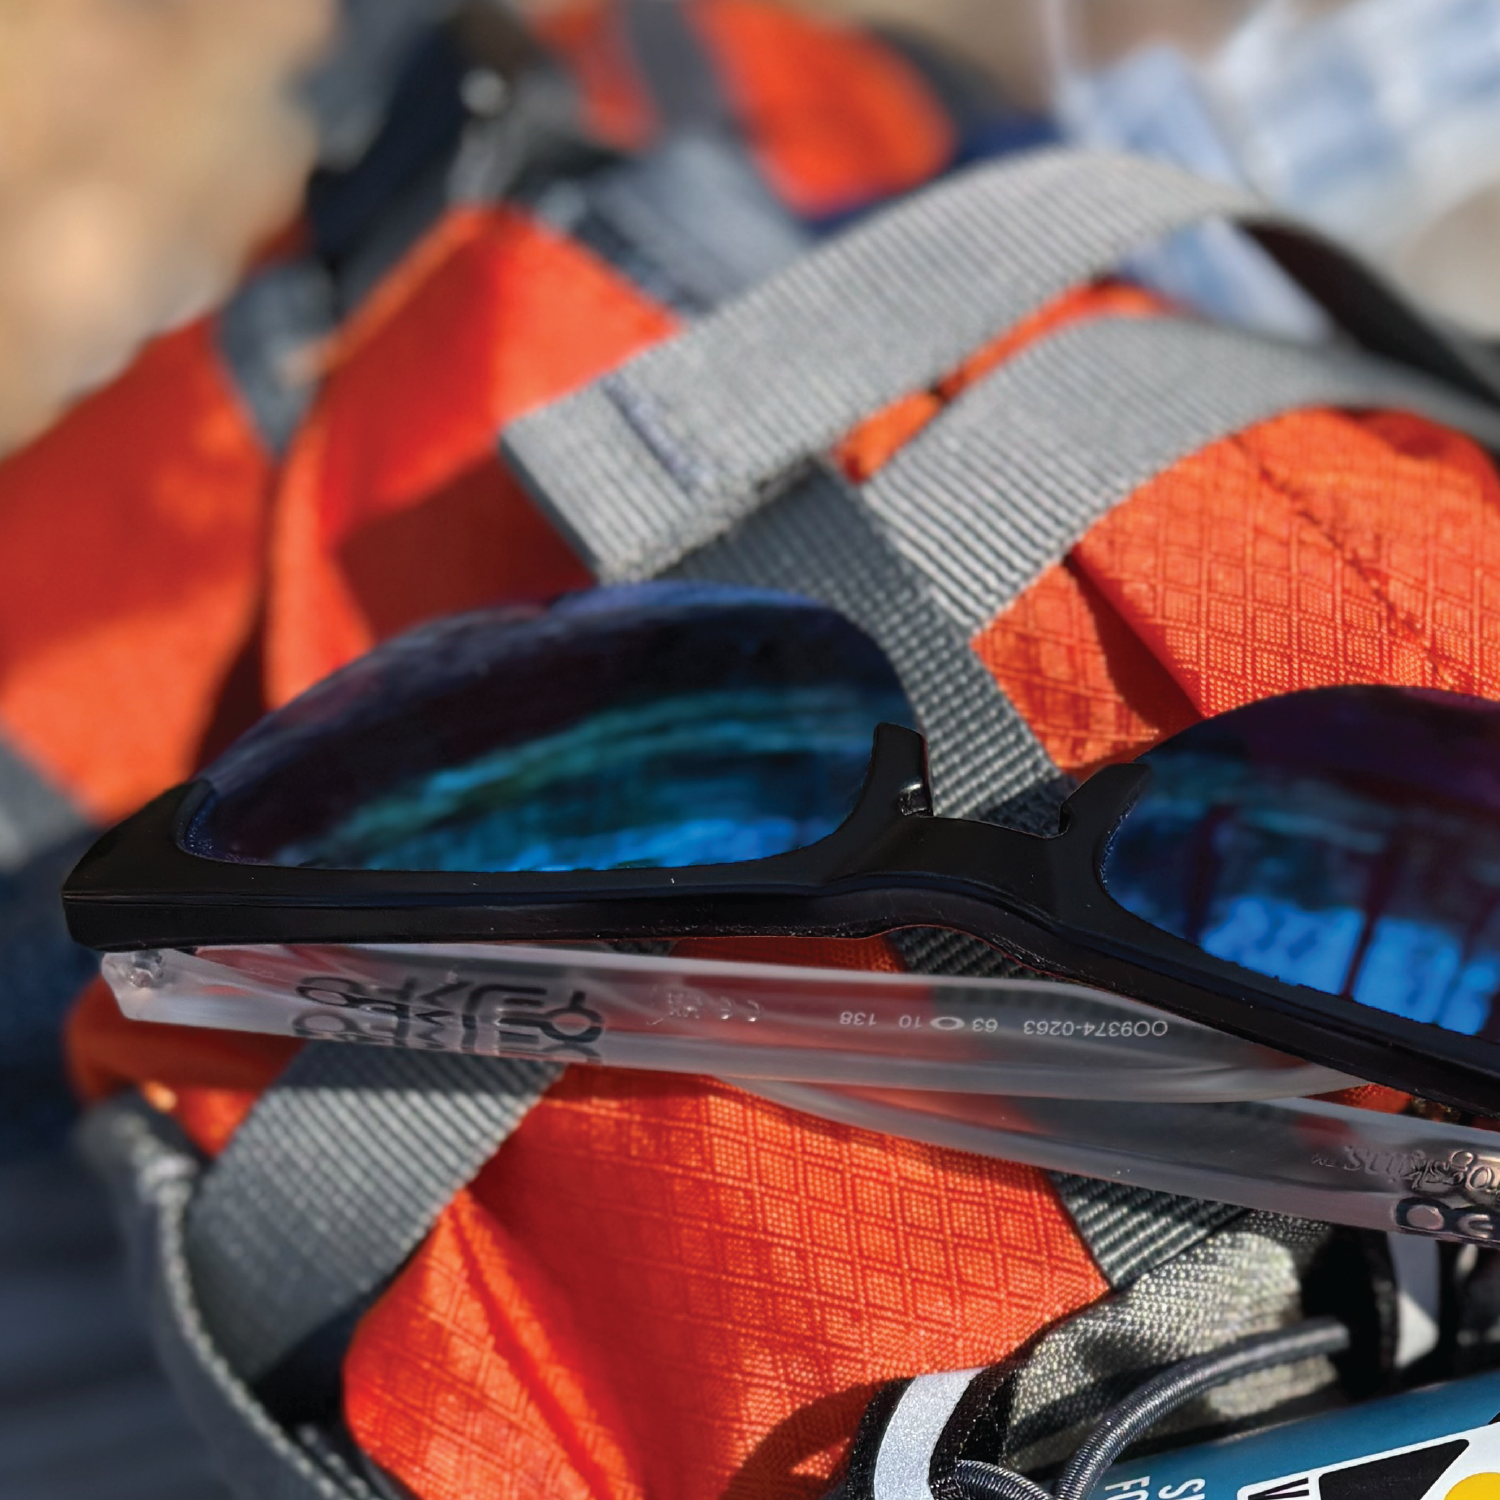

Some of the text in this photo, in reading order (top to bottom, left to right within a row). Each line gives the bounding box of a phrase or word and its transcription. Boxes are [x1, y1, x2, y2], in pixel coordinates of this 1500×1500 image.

[838, 1010, 879, 1027] 138
[898, 1014, 922, 1030] 10
[971, 1017, 999, 1034] 63
